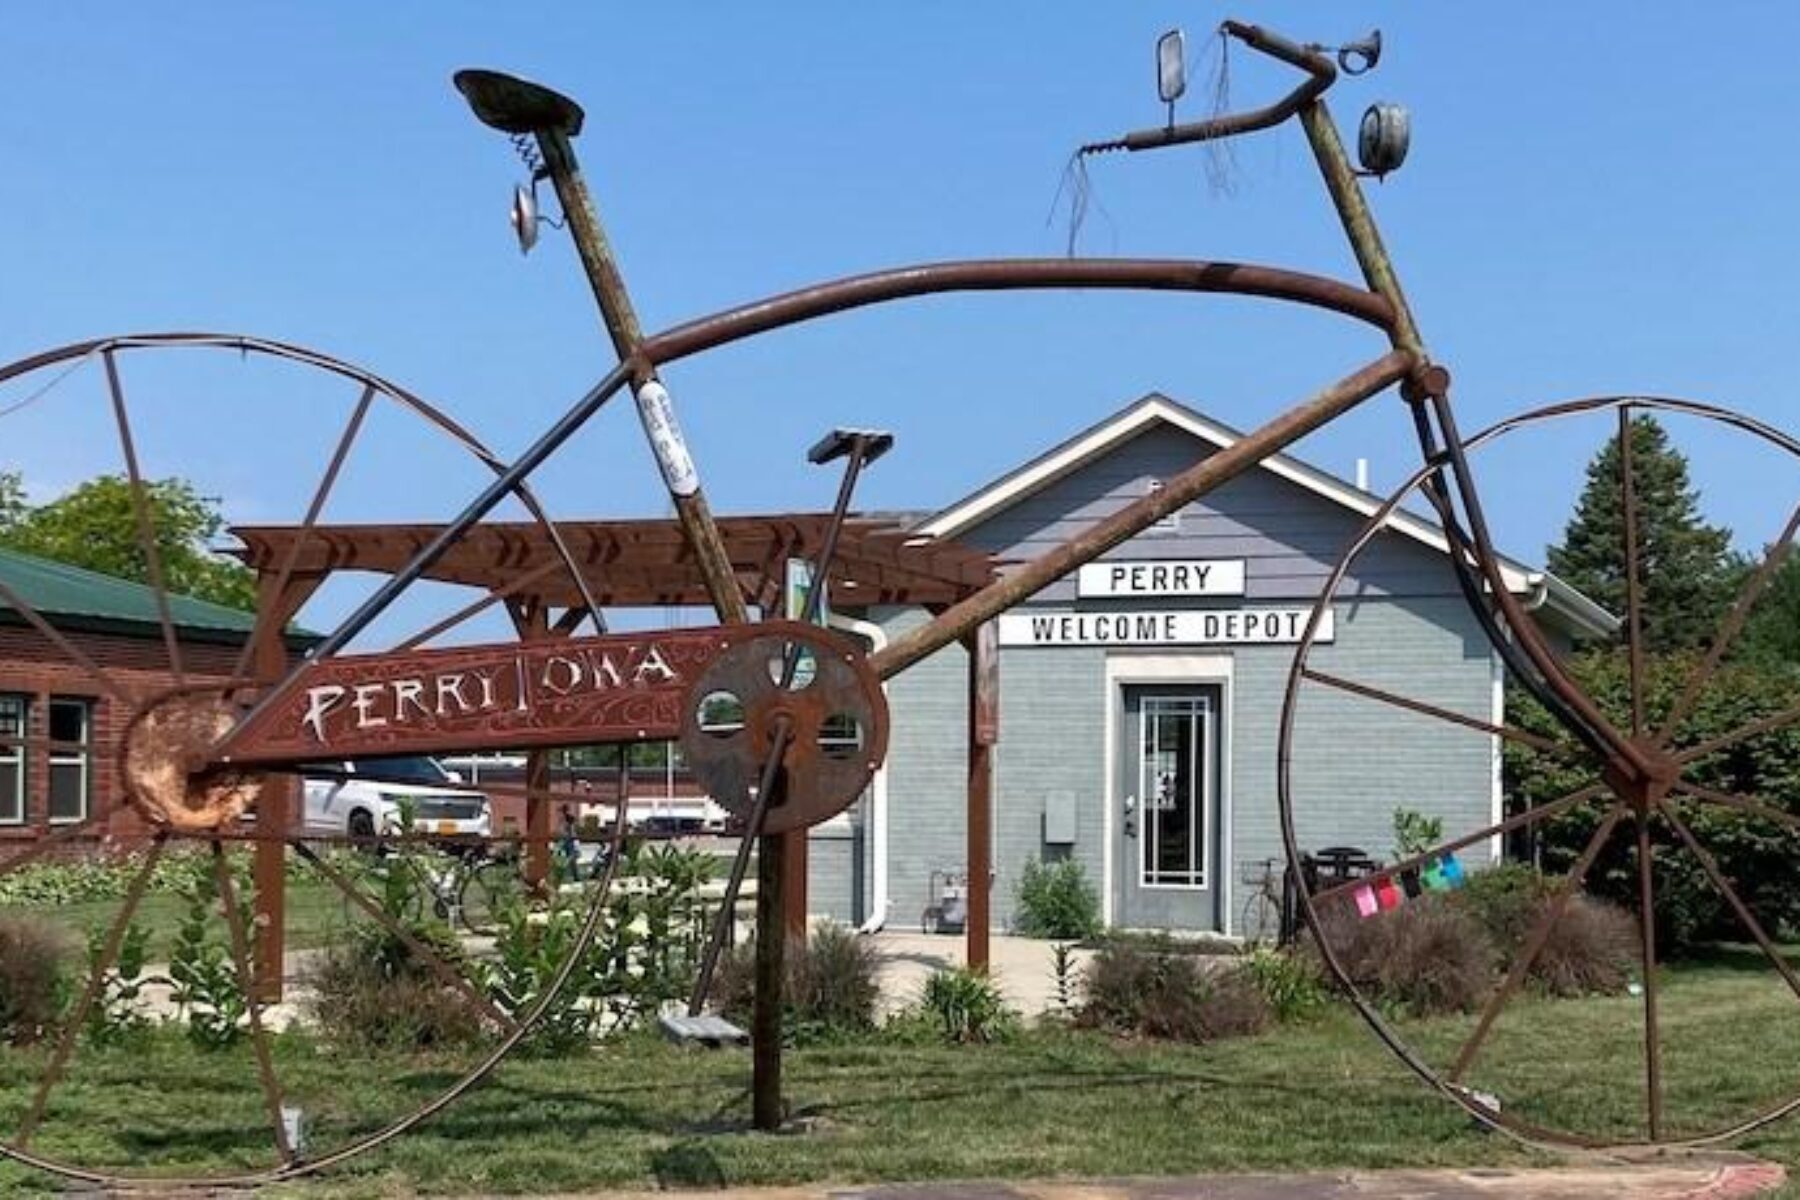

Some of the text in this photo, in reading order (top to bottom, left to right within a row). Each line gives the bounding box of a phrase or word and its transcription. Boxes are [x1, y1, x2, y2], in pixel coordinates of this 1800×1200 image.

[1111, 565, 1211, 591] PERRY
[1033, 612, 1300, 641] WELCOME DEPOT
[303, 671, 495, 744] PERRY
